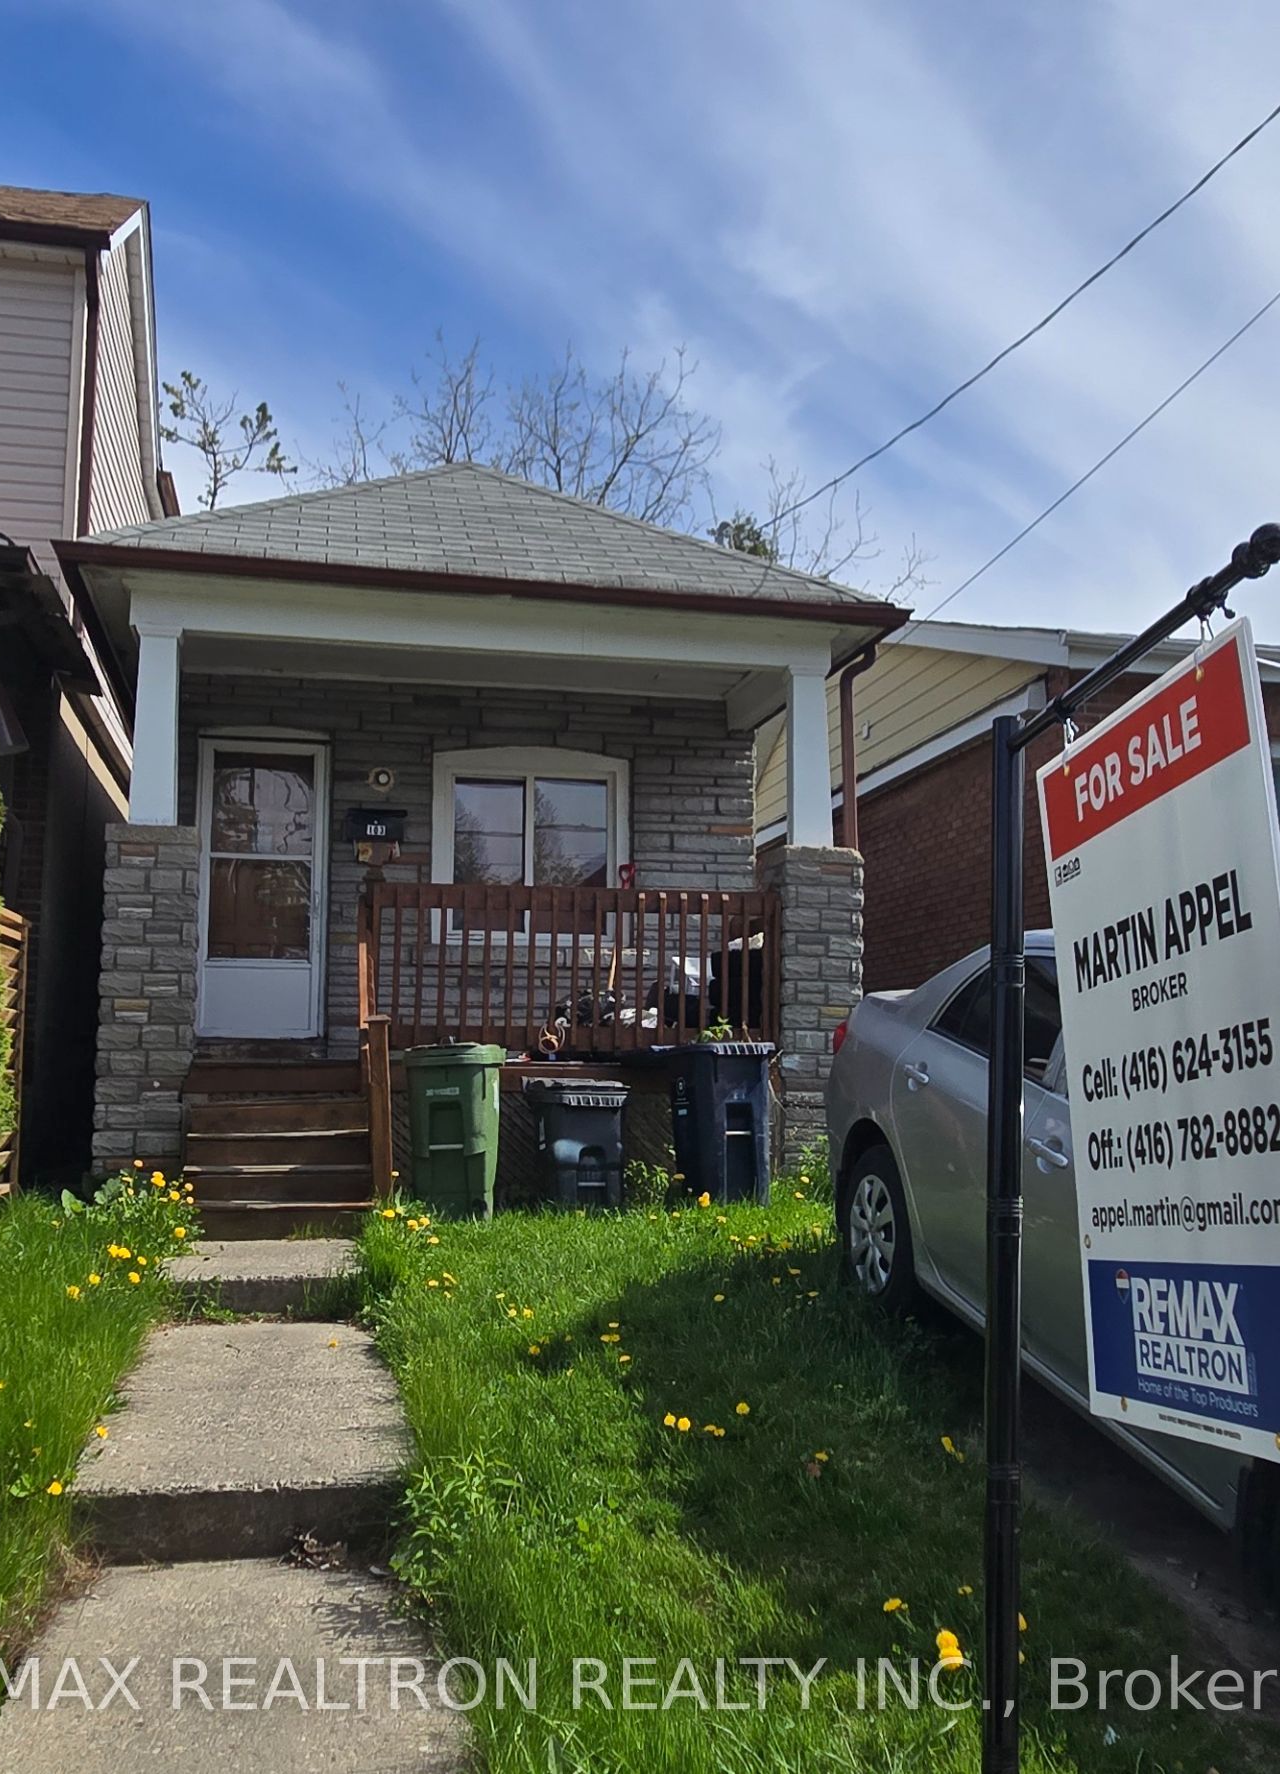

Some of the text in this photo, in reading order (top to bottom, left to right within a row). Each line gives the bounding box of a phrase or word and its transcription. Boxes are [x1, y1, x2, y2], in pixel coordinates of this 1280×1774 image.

[1074, 694, 1202, 823] FOR SALE
[1073, 868, 1253, 993] MARTIN APPEL
[1131, 971, 1189, 1012] BROKER
[1082, 1017, 1273, 1102] Cell: (416) 624-3155
[1088, 1127, 1123, 1171] Off.:
[1127, 1120, 1173, 1173] (416)
[1138, 1338, 1244, 1386] REALTRON
[1138, 1378, 1259, 1418] Home of the Top Producers
